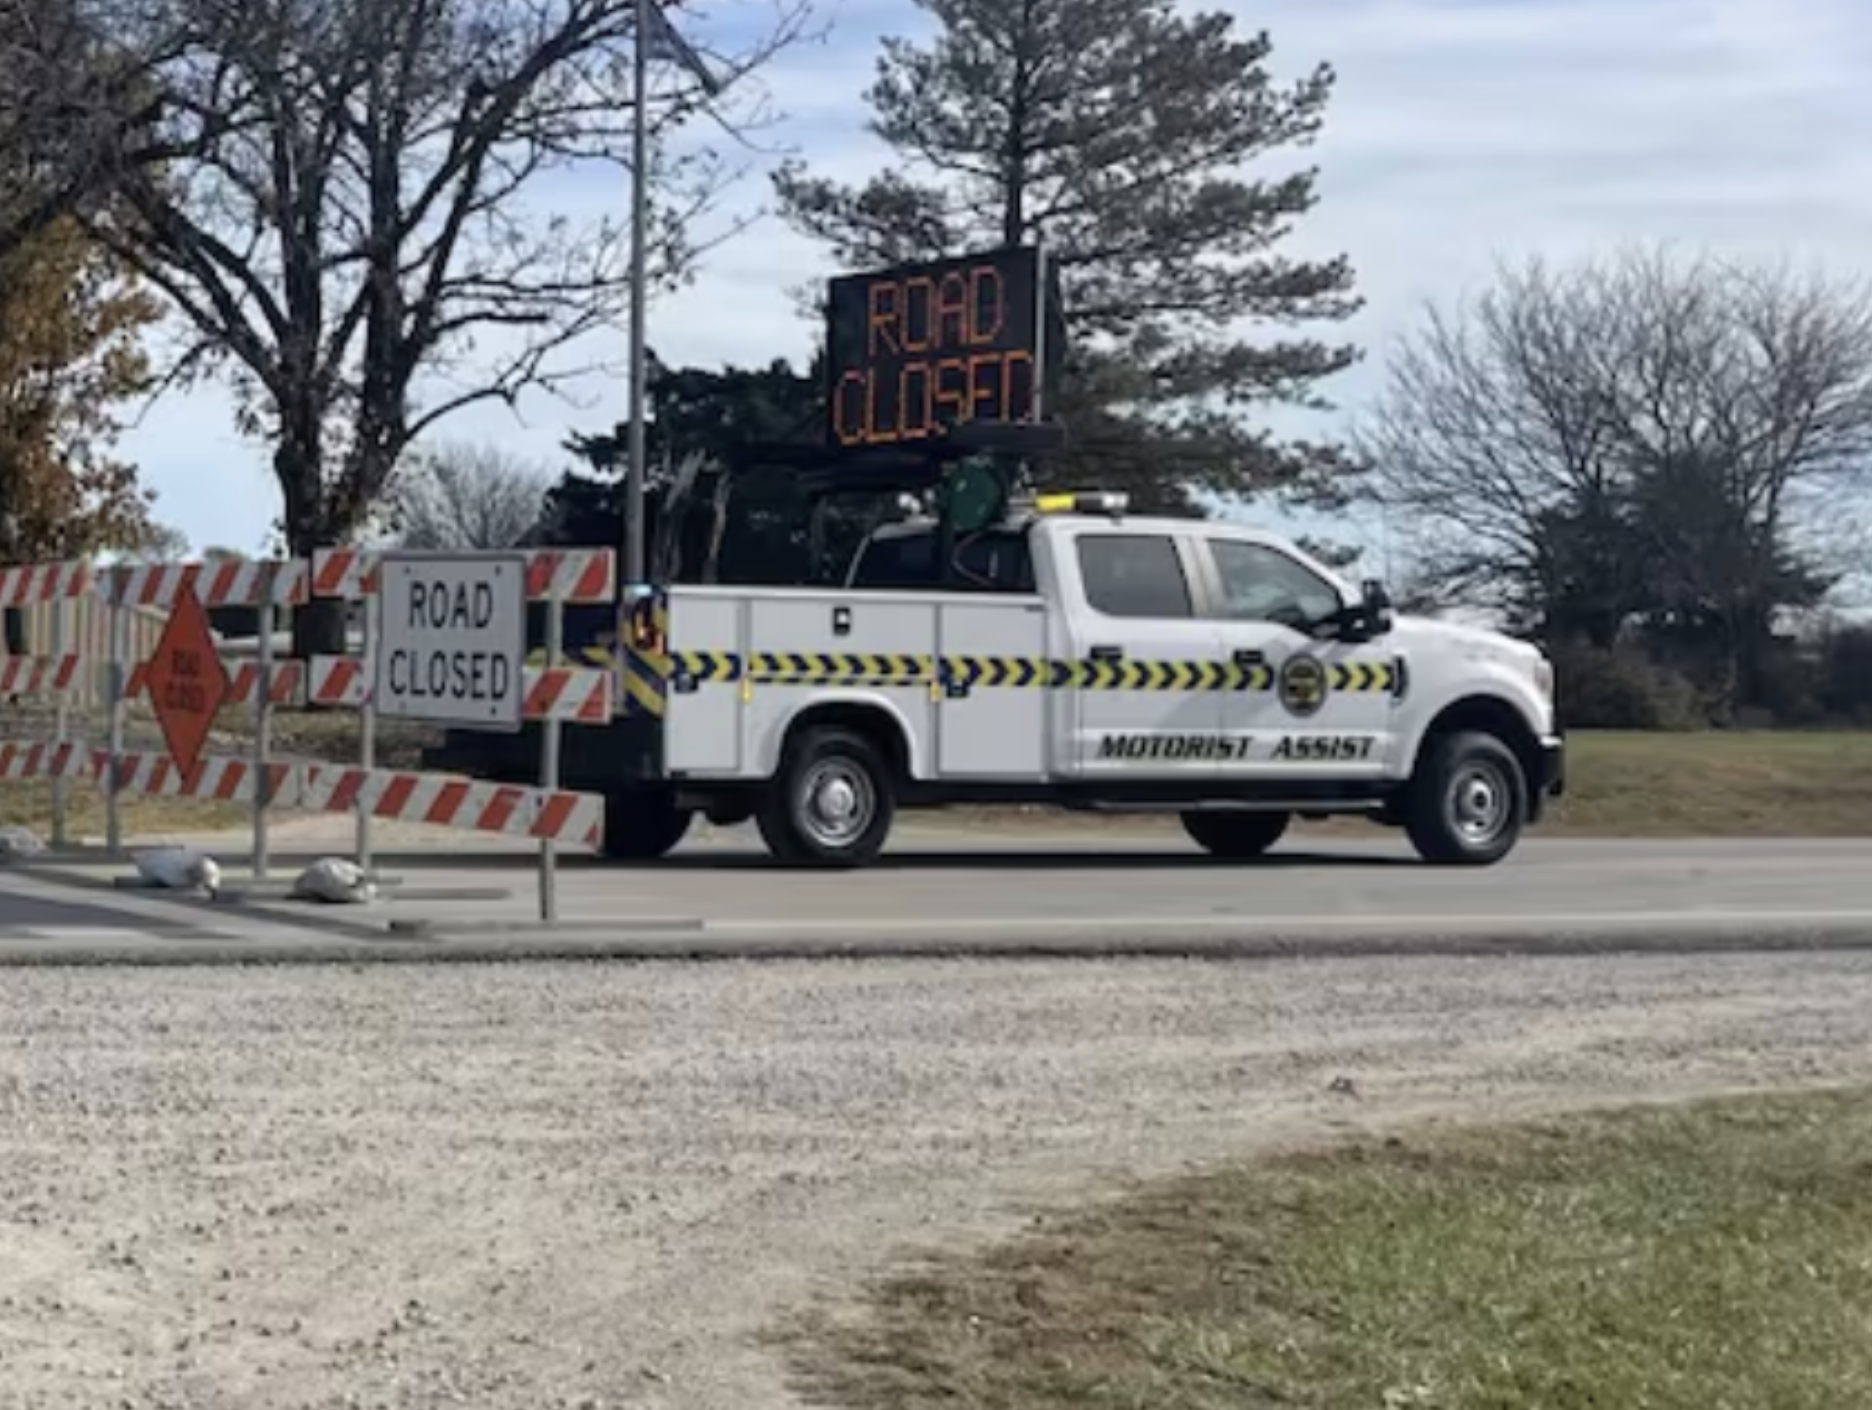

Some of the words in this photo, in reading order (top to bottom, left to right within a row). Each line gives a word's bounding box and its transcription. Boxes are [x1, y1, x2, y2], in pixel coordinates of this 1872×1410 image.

[868, 264, 1002, 356] ROAD
[833, 350, 1035, 445] CLOSED
[408, 580, 493, 629] ROAD
[389, 648, 509, 700] CLOSED
[1096, 735, 1254, 760] MOTORIST
[1270, 735, 1376, 760] ASSIST
